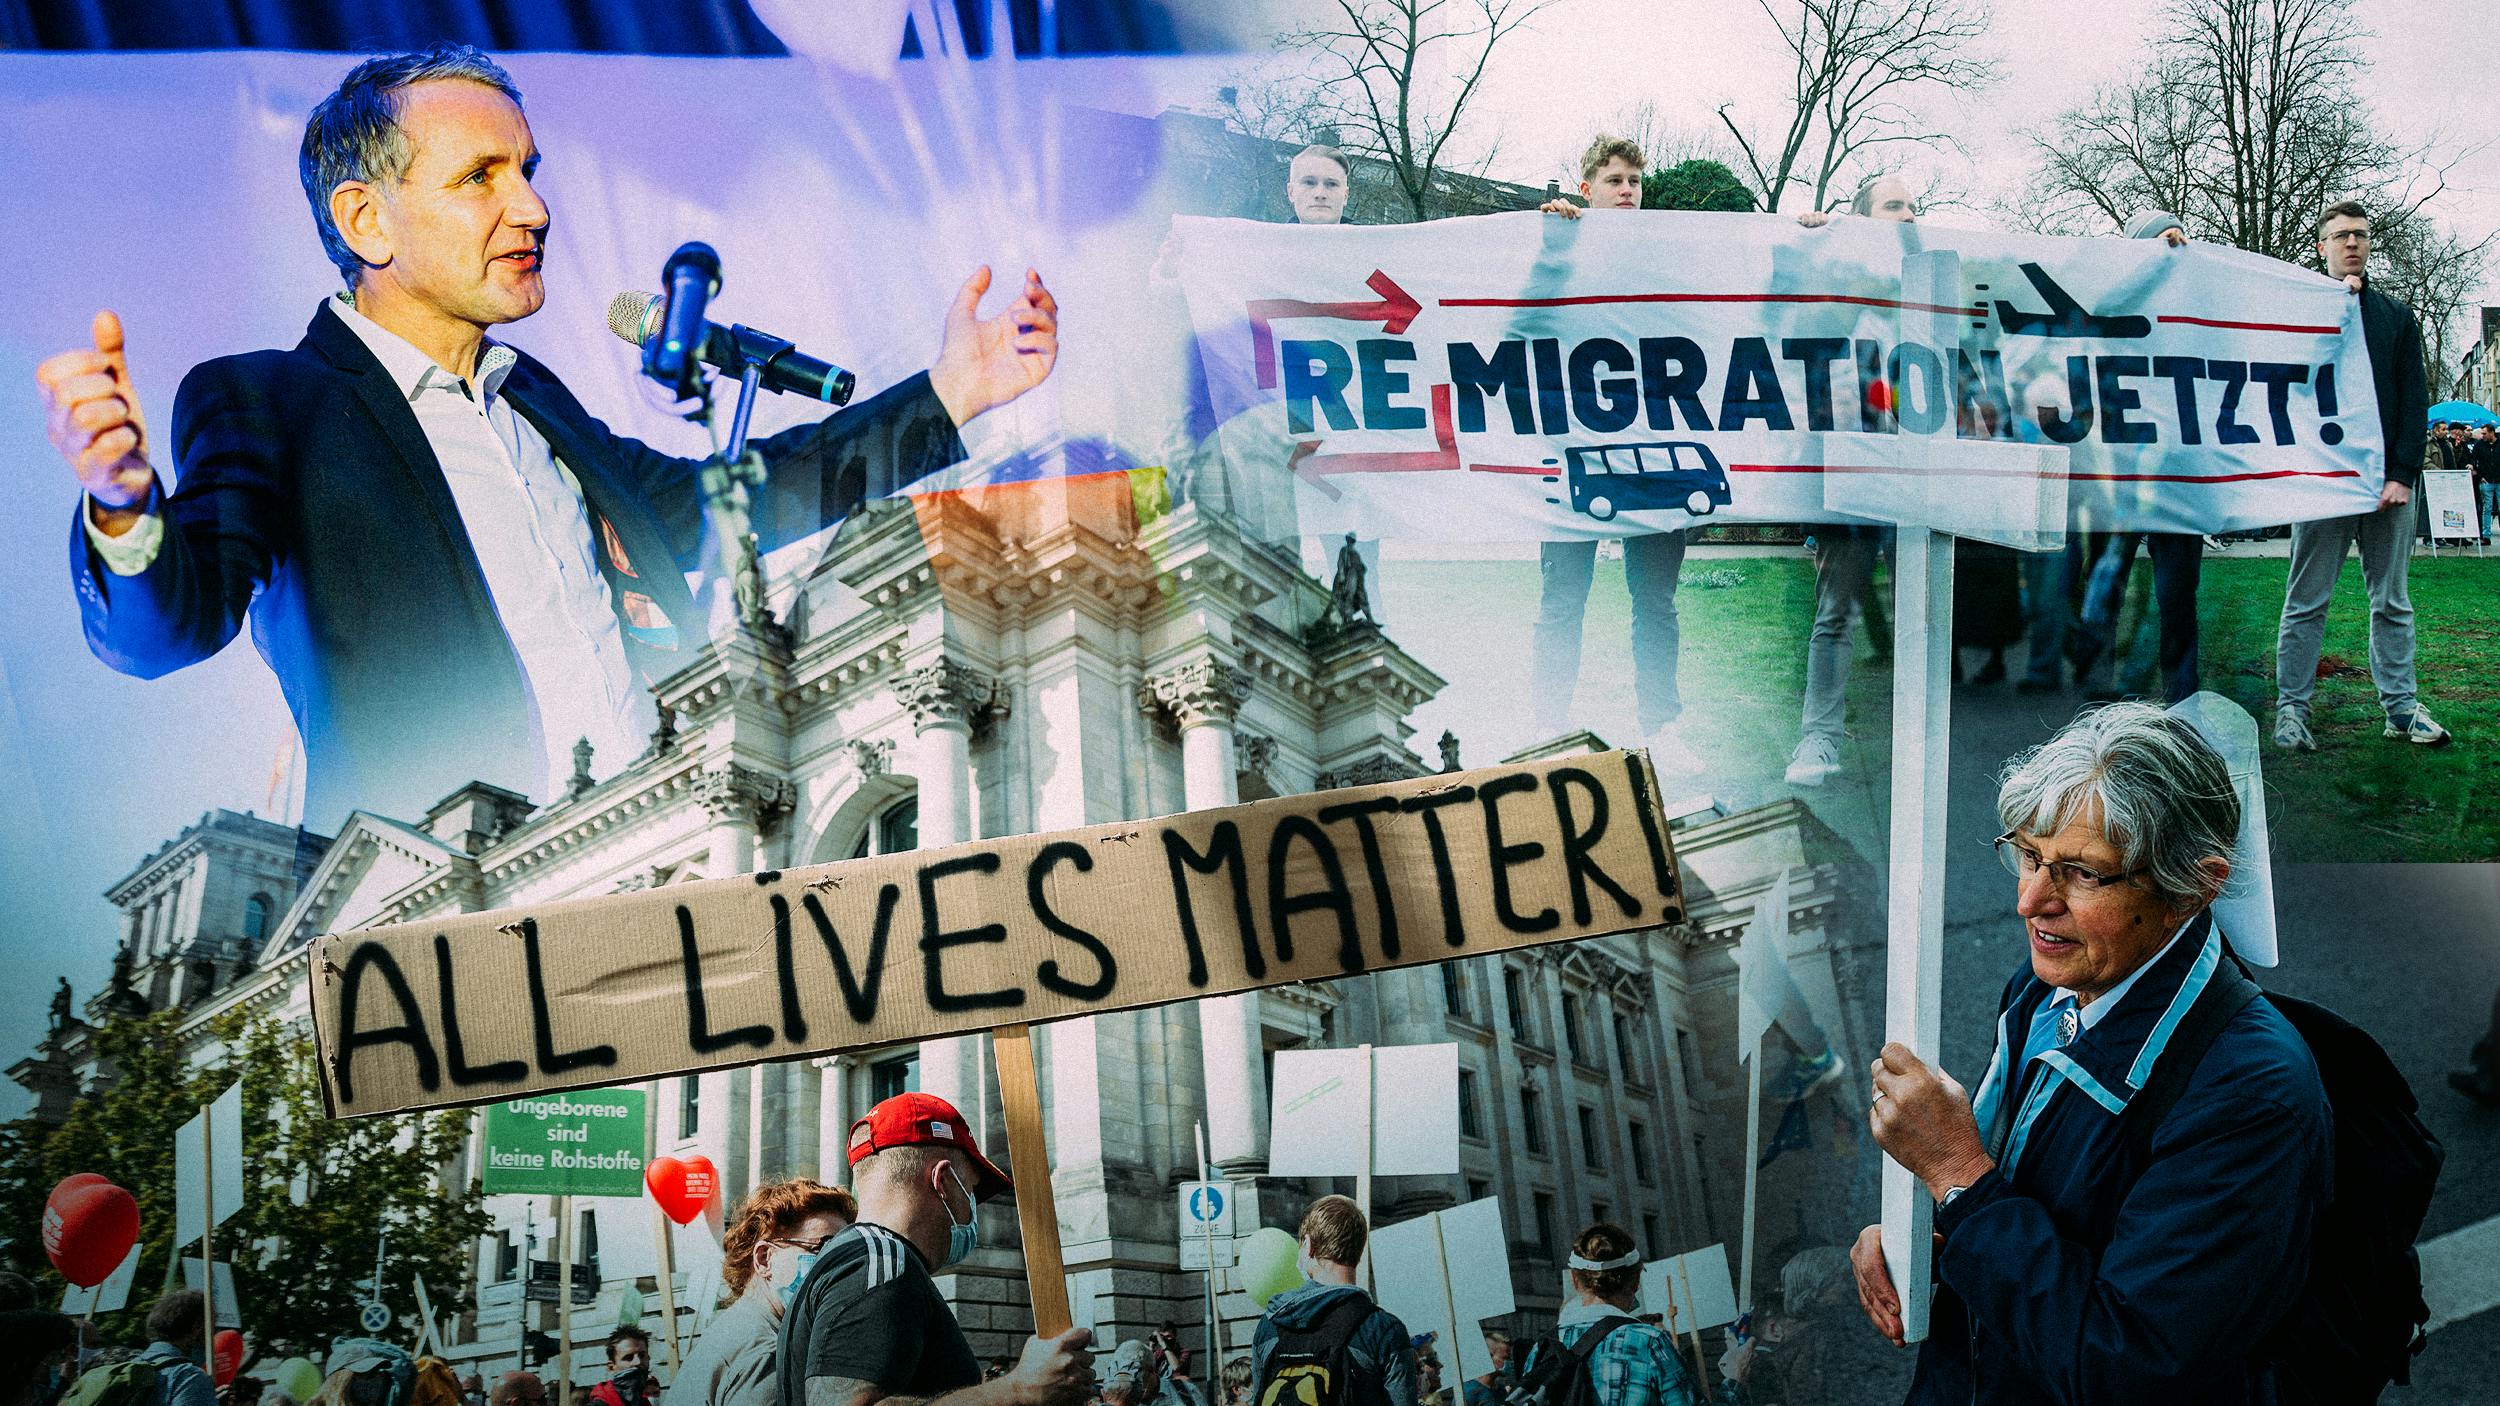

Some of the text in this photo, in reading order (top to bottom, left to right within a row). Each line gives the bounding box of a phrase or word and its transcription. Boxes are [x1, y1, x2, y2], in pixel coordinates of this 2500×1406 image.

[2037, 355, 2344, 446] JETZT!
[337, 917, 617, 1103] ALL
[1162, 755, 1682, 986] MATTER!
[508, 1096, 629, 1120] Ungeborene
[546, 1123, 588, 1143] sind
[489, 1146, 641, 1171] keine Rohstoffe
